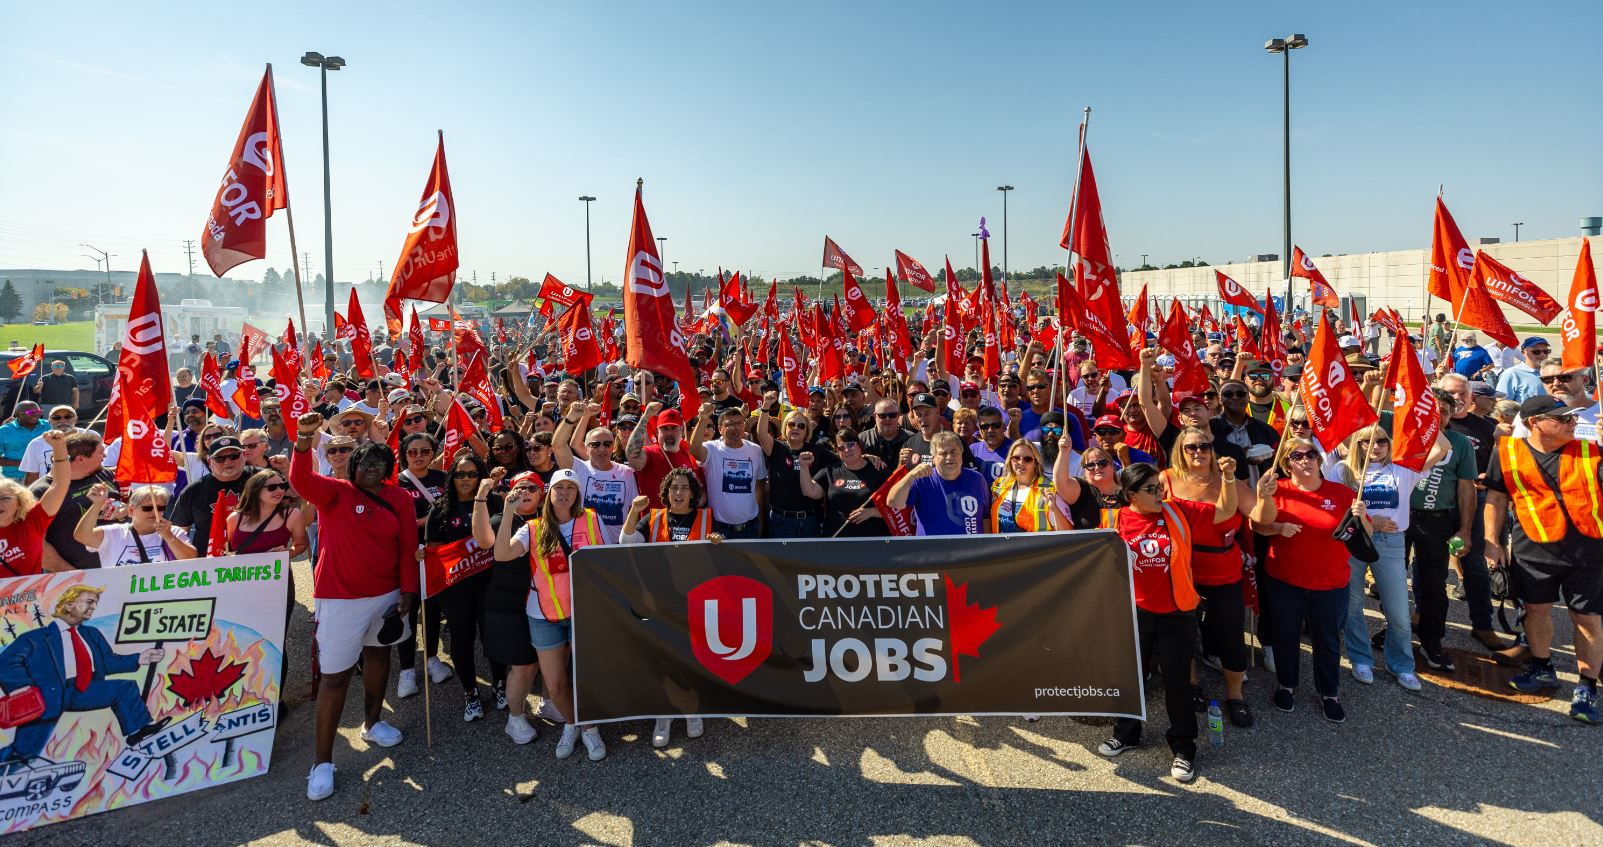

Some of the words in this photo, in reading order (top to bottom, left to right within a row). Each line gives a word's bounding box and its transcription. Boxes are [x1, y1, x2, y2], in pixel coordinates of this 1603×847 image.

[845, 300, 856, 317] FOR
[1423, 467, 1444, 510] UNIFOR
[1128, 533, 1146, 545] LYING
[1148, 532, 1170, 541] SQUA
[797, 573, 939, 600] PROTECT
[156, 613, 207, 634] STATE
[798, 605, 944, 631] CANADIAN
[802, 638, 948, 684] JOBS
[1034, 684, 1121, 700] protectjobs.ca
